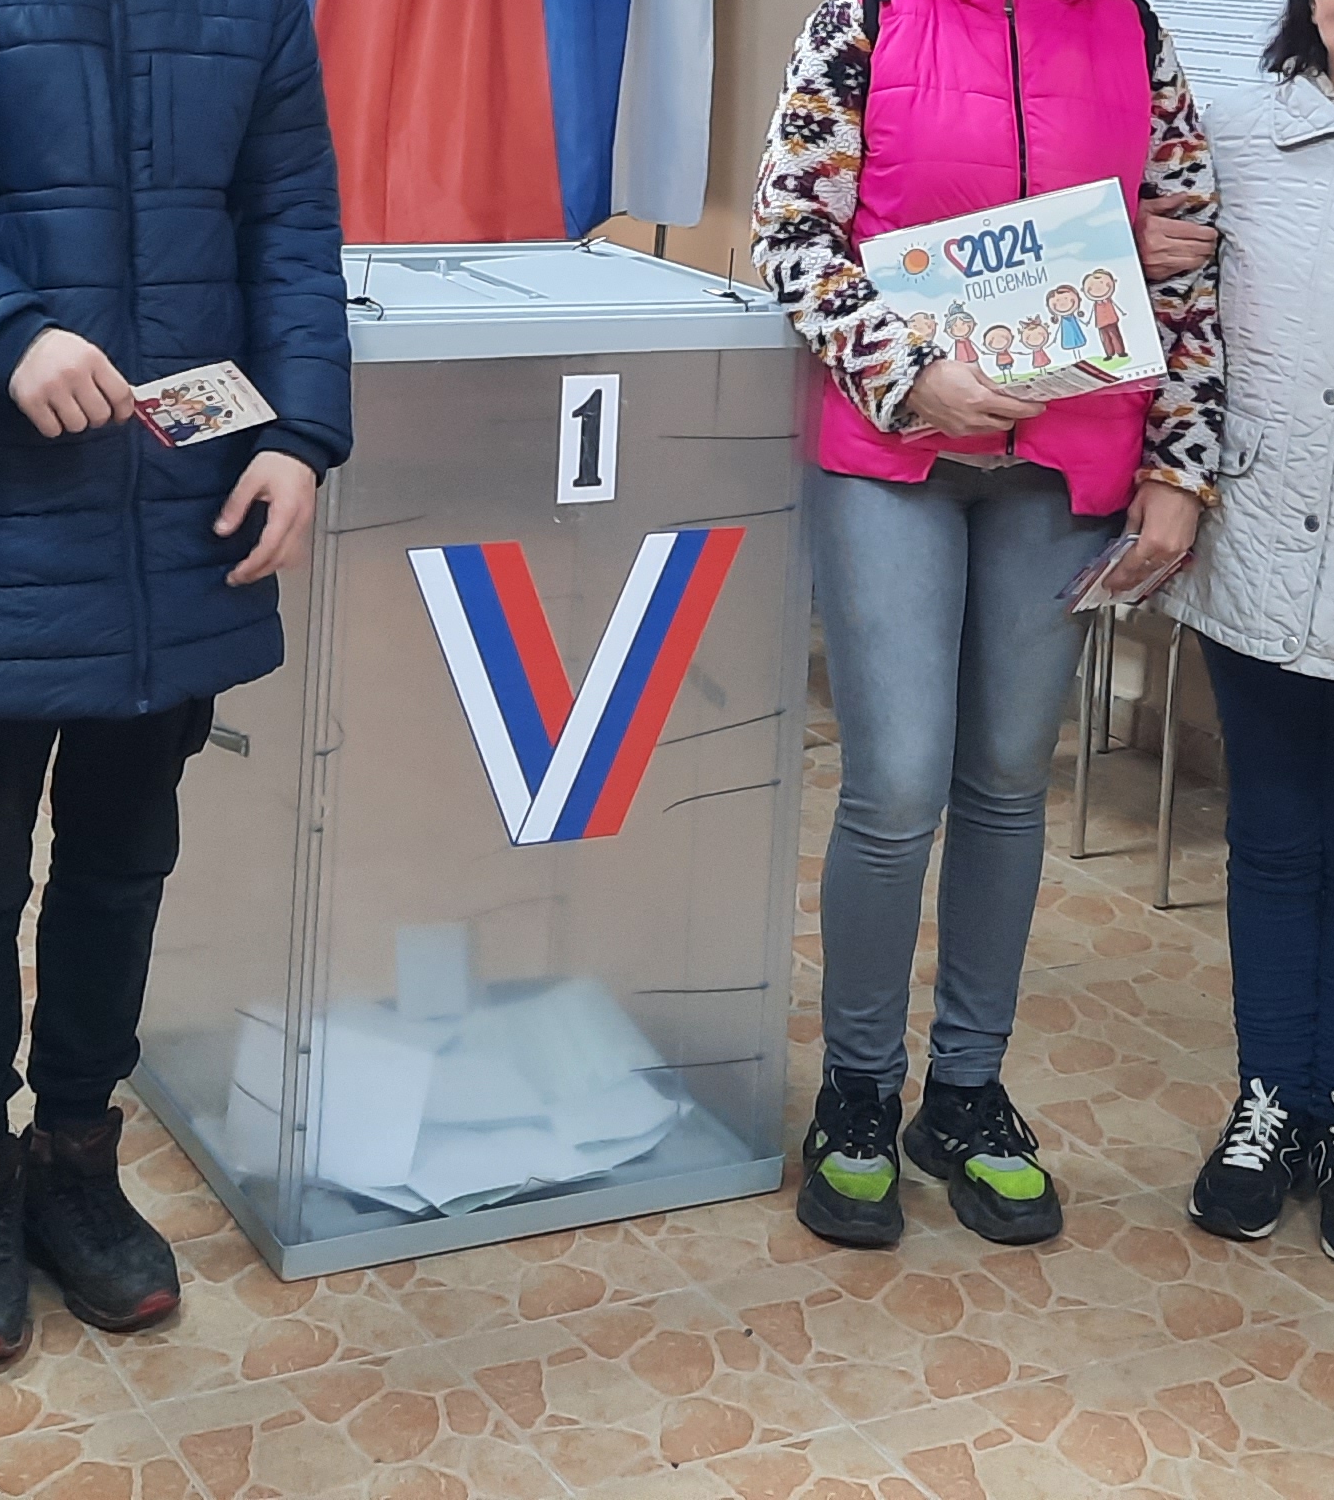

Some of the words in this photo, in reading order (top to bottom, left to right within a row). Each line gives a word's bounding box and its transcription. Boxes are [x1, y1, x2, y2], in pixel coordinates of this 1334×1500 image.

[957, 220, 1043, 278] 2024
[572, 389, 602, 487] 1
[406, 527, 746, 846] V
